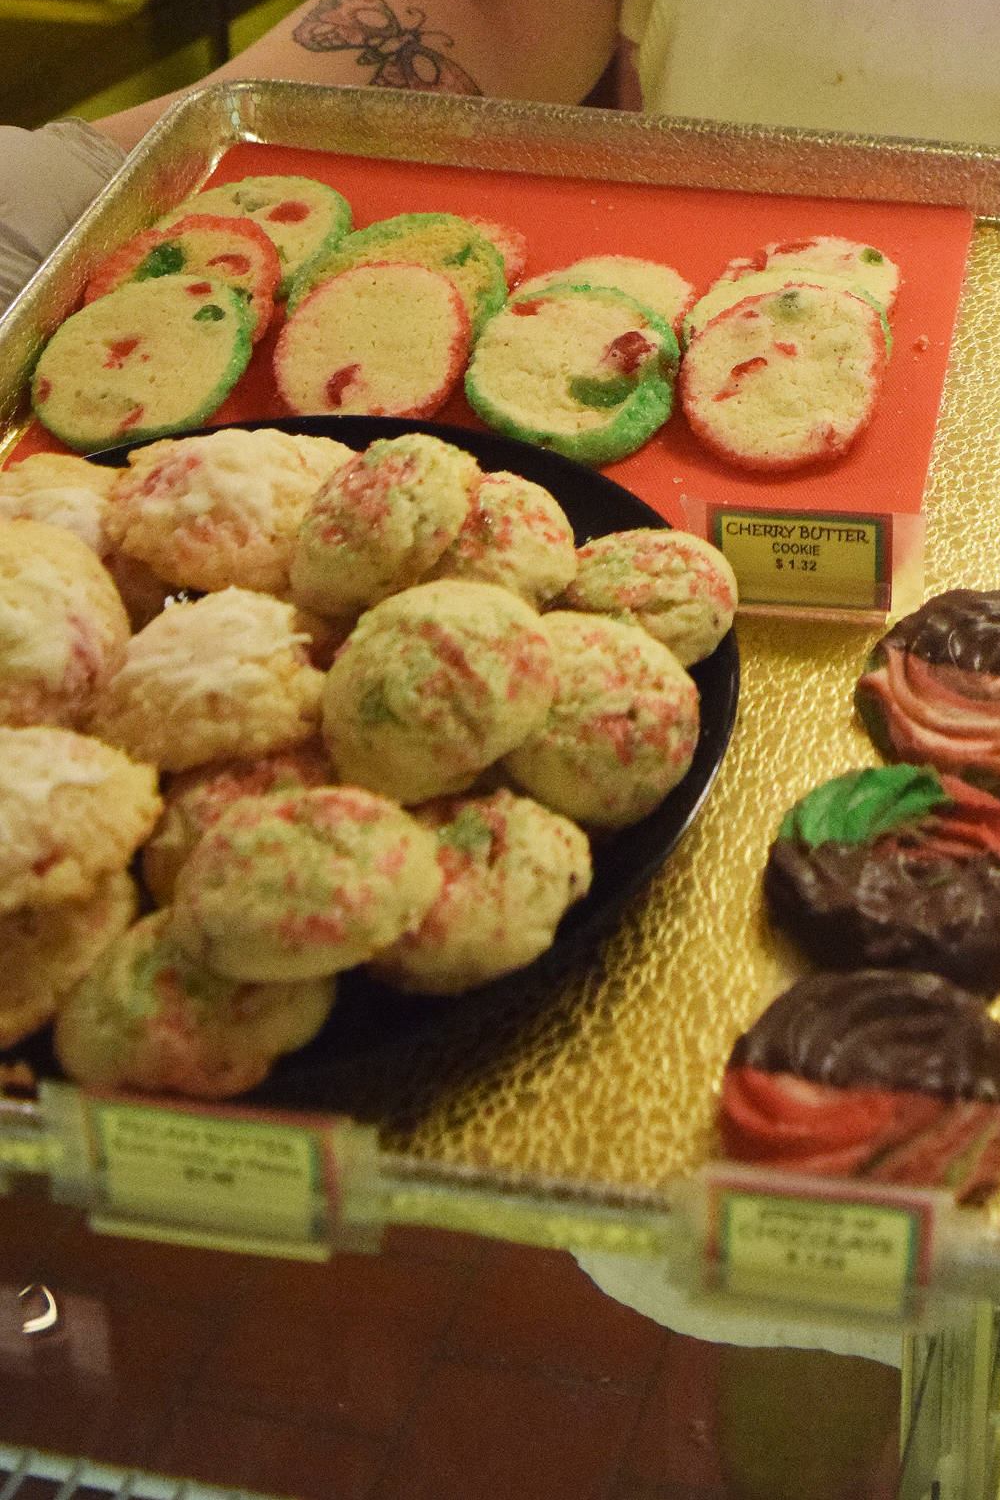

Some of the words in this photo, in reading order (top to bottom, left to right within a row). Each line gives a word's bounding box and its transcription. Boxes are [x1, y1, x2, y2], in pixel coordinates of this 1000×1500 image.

[726, 521, 795, 540] CHERRY
[799, 525, 870, 545] BUTTER
[772, 542, 821, 557] COOKIE
[788, 558, 818, 572] 1.32
